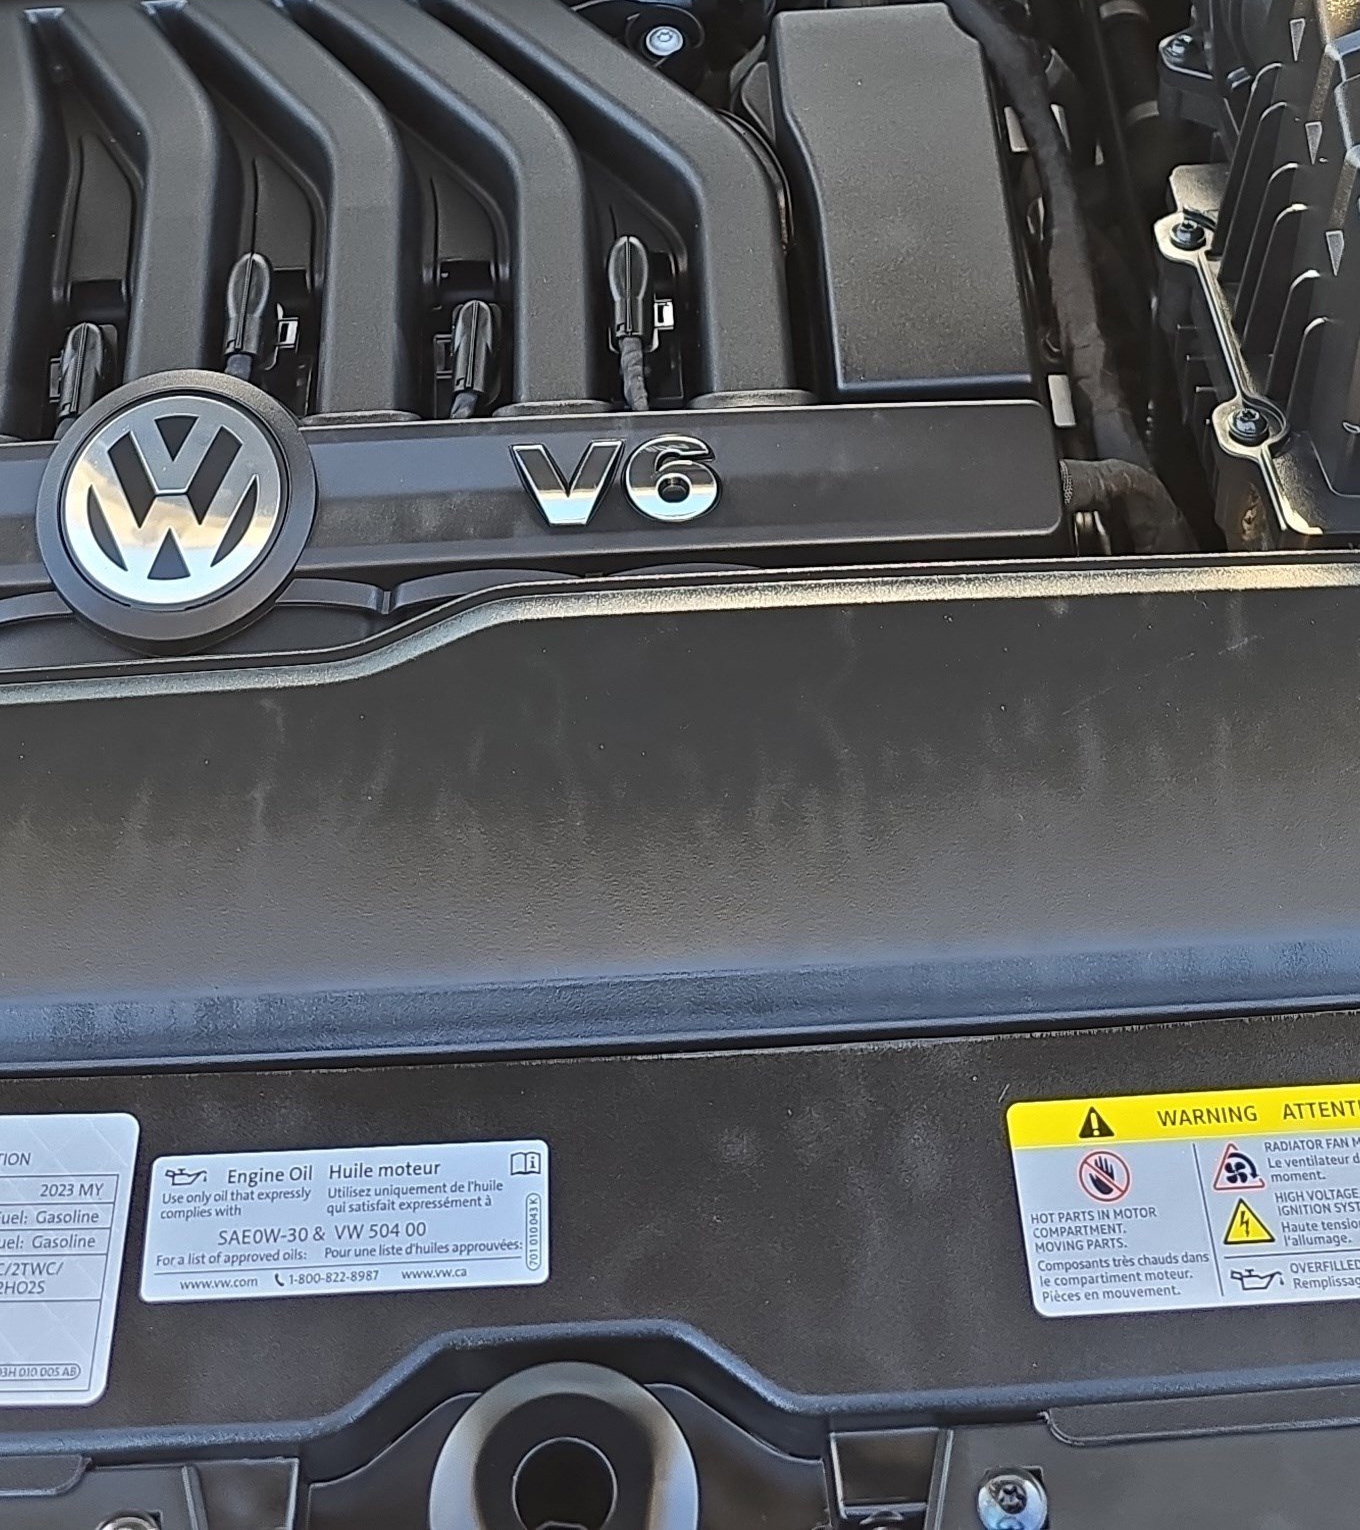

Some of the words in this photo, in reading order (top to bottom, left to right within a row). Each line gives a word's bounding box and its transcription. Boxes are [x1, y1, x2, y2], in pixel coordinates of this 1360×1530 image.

[508, 433, 722, 529] V6
[1157, 1106, 1257, 1126] WARNING
[1264, 1139, 1322, 1152] RADIATOR
[1326, 1137, 1349, 1149] FAN
[1268, 1158, 1281, 1168] Le
[1285, 1153, 1349, 1168] ventilateur
[228, 1169, 284, 1187] Engine
[290, 1165, 312, 1181] Oil
[329, 1163, 372, 1179] Huile
[378, 1162, 440, 1177] moteur
[1271, 1171, 1326, 1183] moment.
[40, 1183, 74, 1197] 2023
[78, 1183, 104, 1196] MY
[162, 1193, 183, 1204] Use
[186, 1192, 211, 1206] only
[214, 1190, 227, 1202] oil
[231, 1190, 254, 1201] that
[257, 1187, 311, 1203] expressly
[328, 1186, 371, 1198] Utilisez
[374, 1182, 447, 1198] uniquement
[450, 1181, 465, 1193] de
[468, 1180, 503, 1192] l'huile
[1275, 1191, 1304, 1203] HIGH
[161, 1206, 212, 1220] complies
[215, 1205, 241, 1216] with
[327, 1201, 346, 1215] qui
[349, 1198, 395, 1212] satisfait
[399, 1196, 482, 1213] expressément
[1278, 1204, 1331, 1216] IGNITION
[35, 1209, 99, 1224] Gasoline
[1031, 1213, 1054, 1225] HOT
[1058, 1210, 1095, 1223] PARTS
[1097, 1209, 1110, 1221] IN
[1113, 1207, 1157, 1220] MOTOR
[218, 1227, 308, 1245] SAE0W-30
[313, 1226, 325, 1241] &
[335, 1224, 364, 1240] VW
[369, 1223, 400, 1238] 504
[405, 1222, 426, 1237] 00
[1033, 1223, 1127, 1239] COMPARTMENT.
[1281, 1221, 1318, 1233] Haute
[32, 1234, 95, 1248] Gasoline
[324, 1246, 351, 1258] Pour
[354, 1245, 376, 1256] une
[379, 1244, 402, 1256] liste
[405, 1242, 449, 1255] d'huiles
[452, 1239, 523, 1255] approuvées:
[1035, 1239, 1084, 1253] MOVING
[1087, 1238, 1128, 1251] PARTS.
[156, 1255, 175, 1266] For
[189, 1252, 205, 1264] list
[209, 1252, 221, 1264] of
[222, 1249, 279, 1266] approved
[283, 1249, 307, 1260] oils:
[1038, 1258, 1110, 1272] Composants
[1112, 1255, 1135, 1267] très
[1138, 1252, 1179, 1266] chauds
[1182, 1252, 1209, 1264] dans
[180, 1277, 258, 1289] www.vw.com
[289, 1270, 379, 1286] 1-800-822-8987
[402, 1268, 467, 1279] www.vw.ca
[1040, 1275, 1052, 1287] le
[1054, 1272, 1141, 1287] compartiment
[1144, 1269, 1193, 1280] moteur.
[1043, 1290, 1081, 1303] Pièces
[1084, 1290, 1099, 1300] en
[1102, 1285, 1181, 1299] mouvement.
